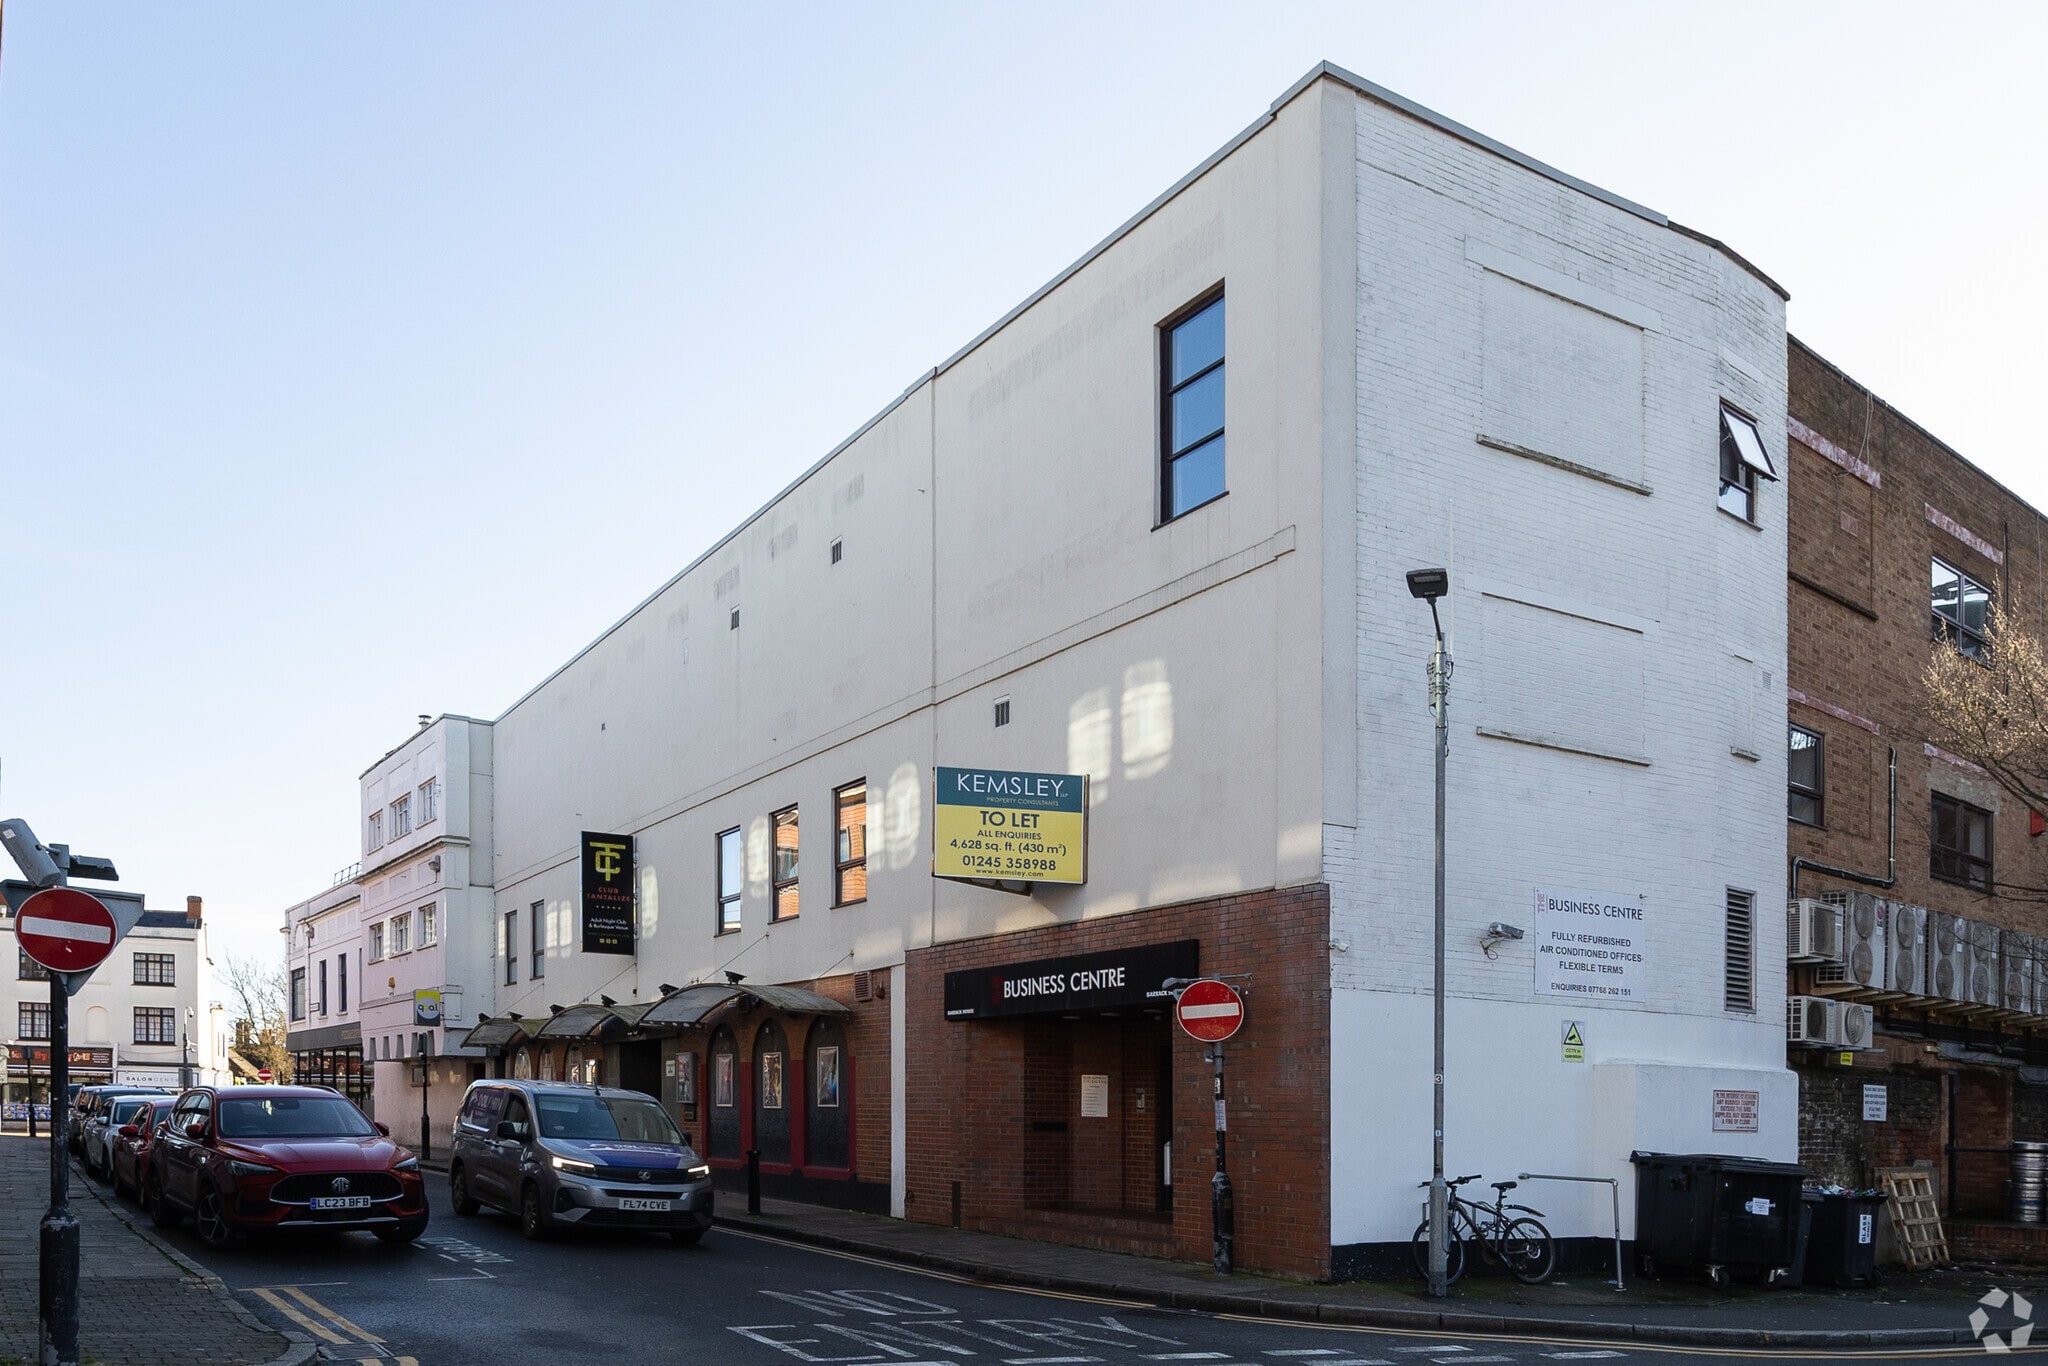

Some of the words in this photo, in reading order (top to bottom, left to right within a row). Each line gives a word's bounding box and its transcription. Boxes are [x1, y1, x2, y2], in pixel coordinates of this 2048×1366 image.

[957, 773, 1064, 797] KEMSLEY
[986, 796, 1016, 805] PROPERTY
[1018, 798, 1059, 807] CONSULTANTS
[980, 811, 1006, 827] TO
[1011, 812, 1040, 829] LET
[977, 829, 993, 838] ALL
[995, 831, 1042, 841] ENQUIRIES
[950, 839, 982, 850] 4,628
[985, 843, 1002, 852] sq.
[1004, 842, 1016, 852] ft.
[1018, 842, 1044, 854] (430
[962, 855, 1001, 868] 01245
[1006, 857, 1057, 871] 358988
[975, 868, 1044, 878] www.kemsley.com
[598, 886, 619, 894] CLUB
[586, 893, 631, 902] TANTALIZE
[1537, 893, 1545, 913] THE
[1549, 898, 1600, 916] BUSINESS
[1603, 905, 1643, 920] CENTRE
[1552, 931, 1576, 942] FULLY
[1577, 934, 1631, 948] REFURBISHED
[1540, 945, 1554, 954] AIR
[1555, 946, 1609, 959] CONDITIONED
[1610, 952, 1642, 963] OFFICES
[1559, 961, 1596, 972] FLEXIBLE
[1597, 964, 1624, 975] TERMS
[1004, 974, 1065, 998] BUSINESS
[1070, 967, 1125, 992] CENTRE
[1551, 982, 1587, 993] ENQUIRIES
[1608, 987, 1619, 995] 262
[1621, 988, 1631, 996] 151
[1435, 1075, 1442, 1084] 3
[332, 1179, 350, 1193] MG
[318, 1198, 346, 1208] LC23
[349, 1197, 369, 1207] BFB
[623, 1199, 647, 1209] FL74
[649, 1201, 668, 1210] CVE
[757, 1289, 959, 1317] NO
[725, 1316, 1189, 1363] ENTRY
